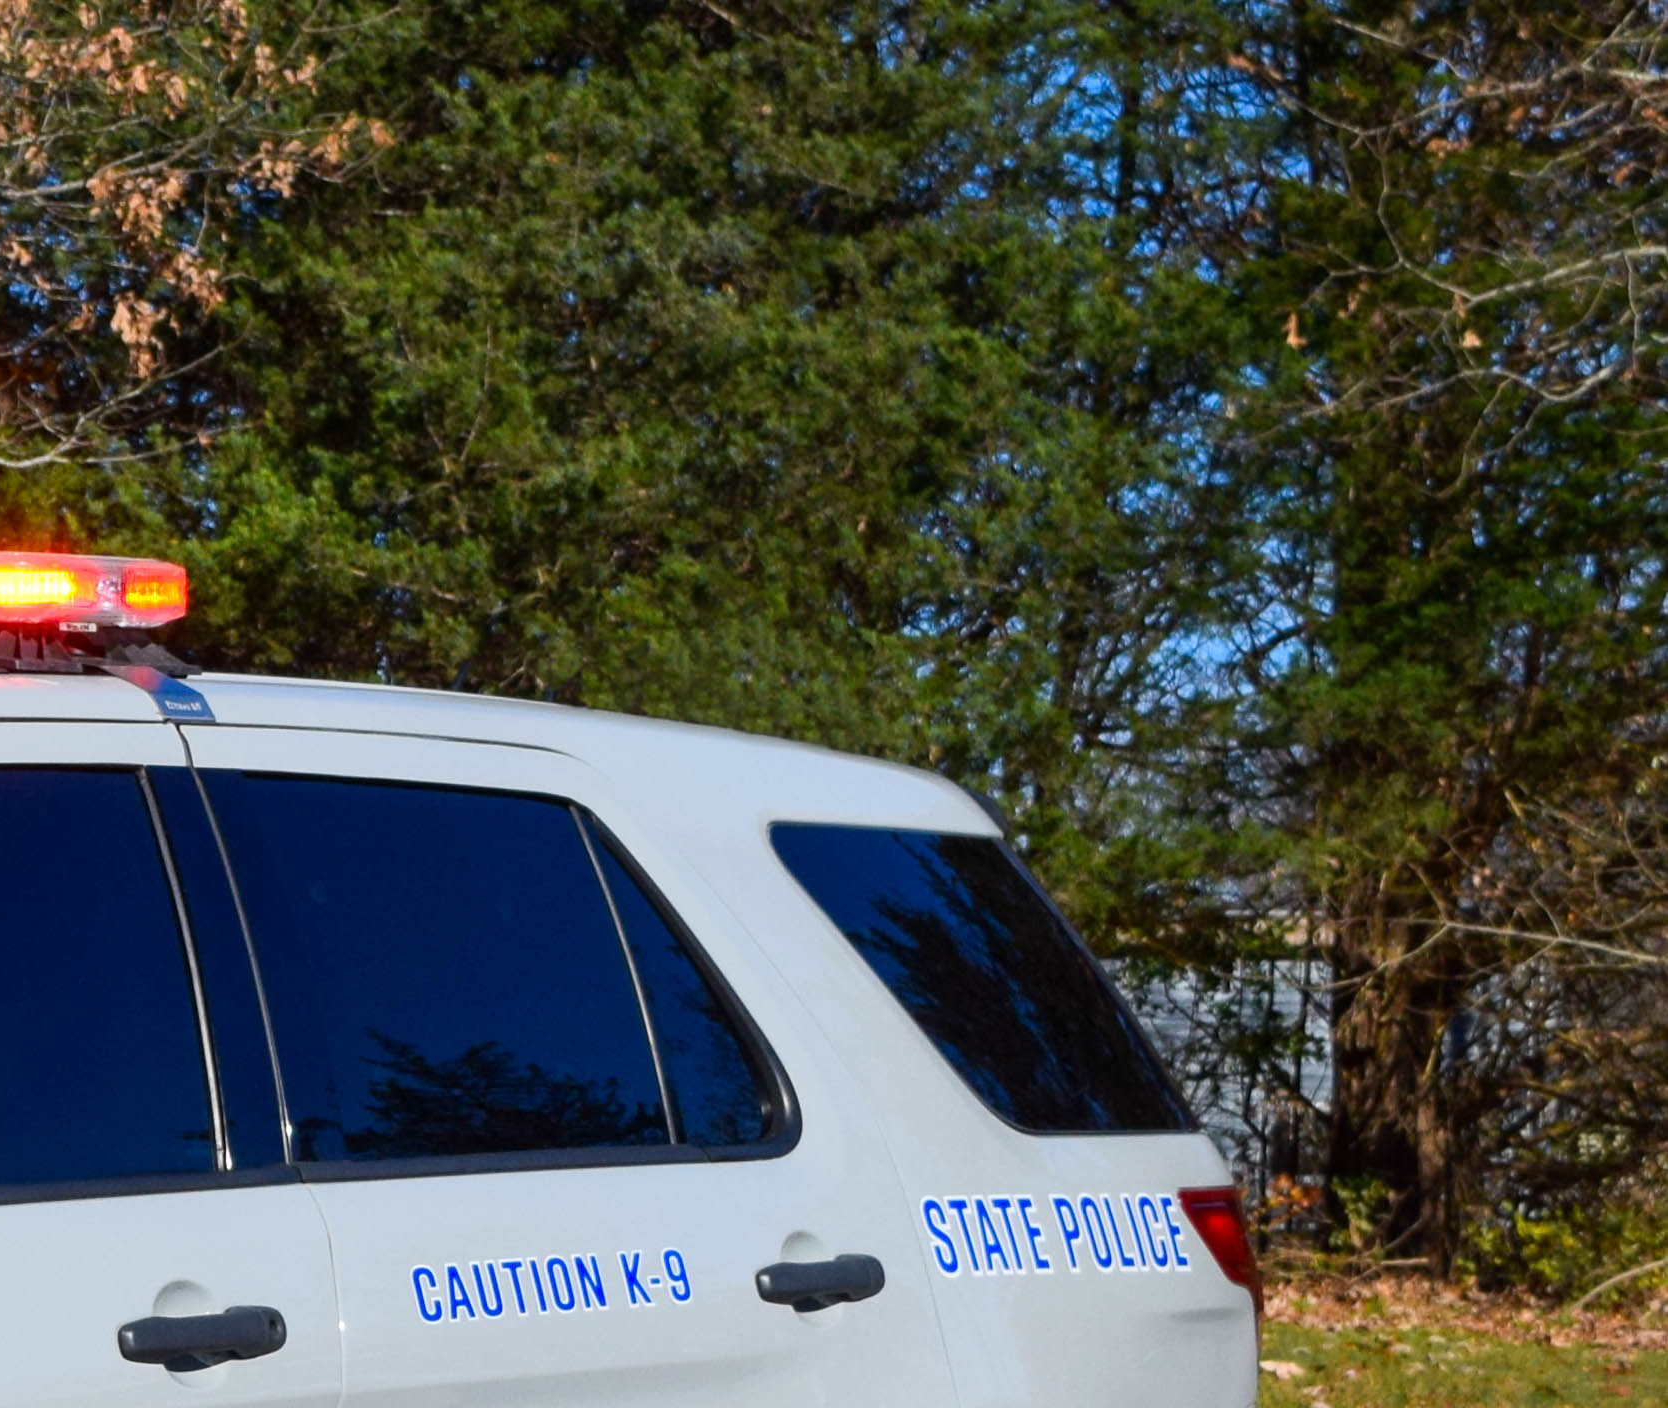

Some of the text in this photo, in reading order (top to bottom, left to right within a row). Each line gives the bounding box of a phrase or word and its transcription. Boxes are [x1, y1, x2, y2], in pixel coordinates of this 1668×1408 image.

[921, 1195, 1190, 1275] STATE POLICE
[411, 1248, 692, 1322] CAUTION K-9
